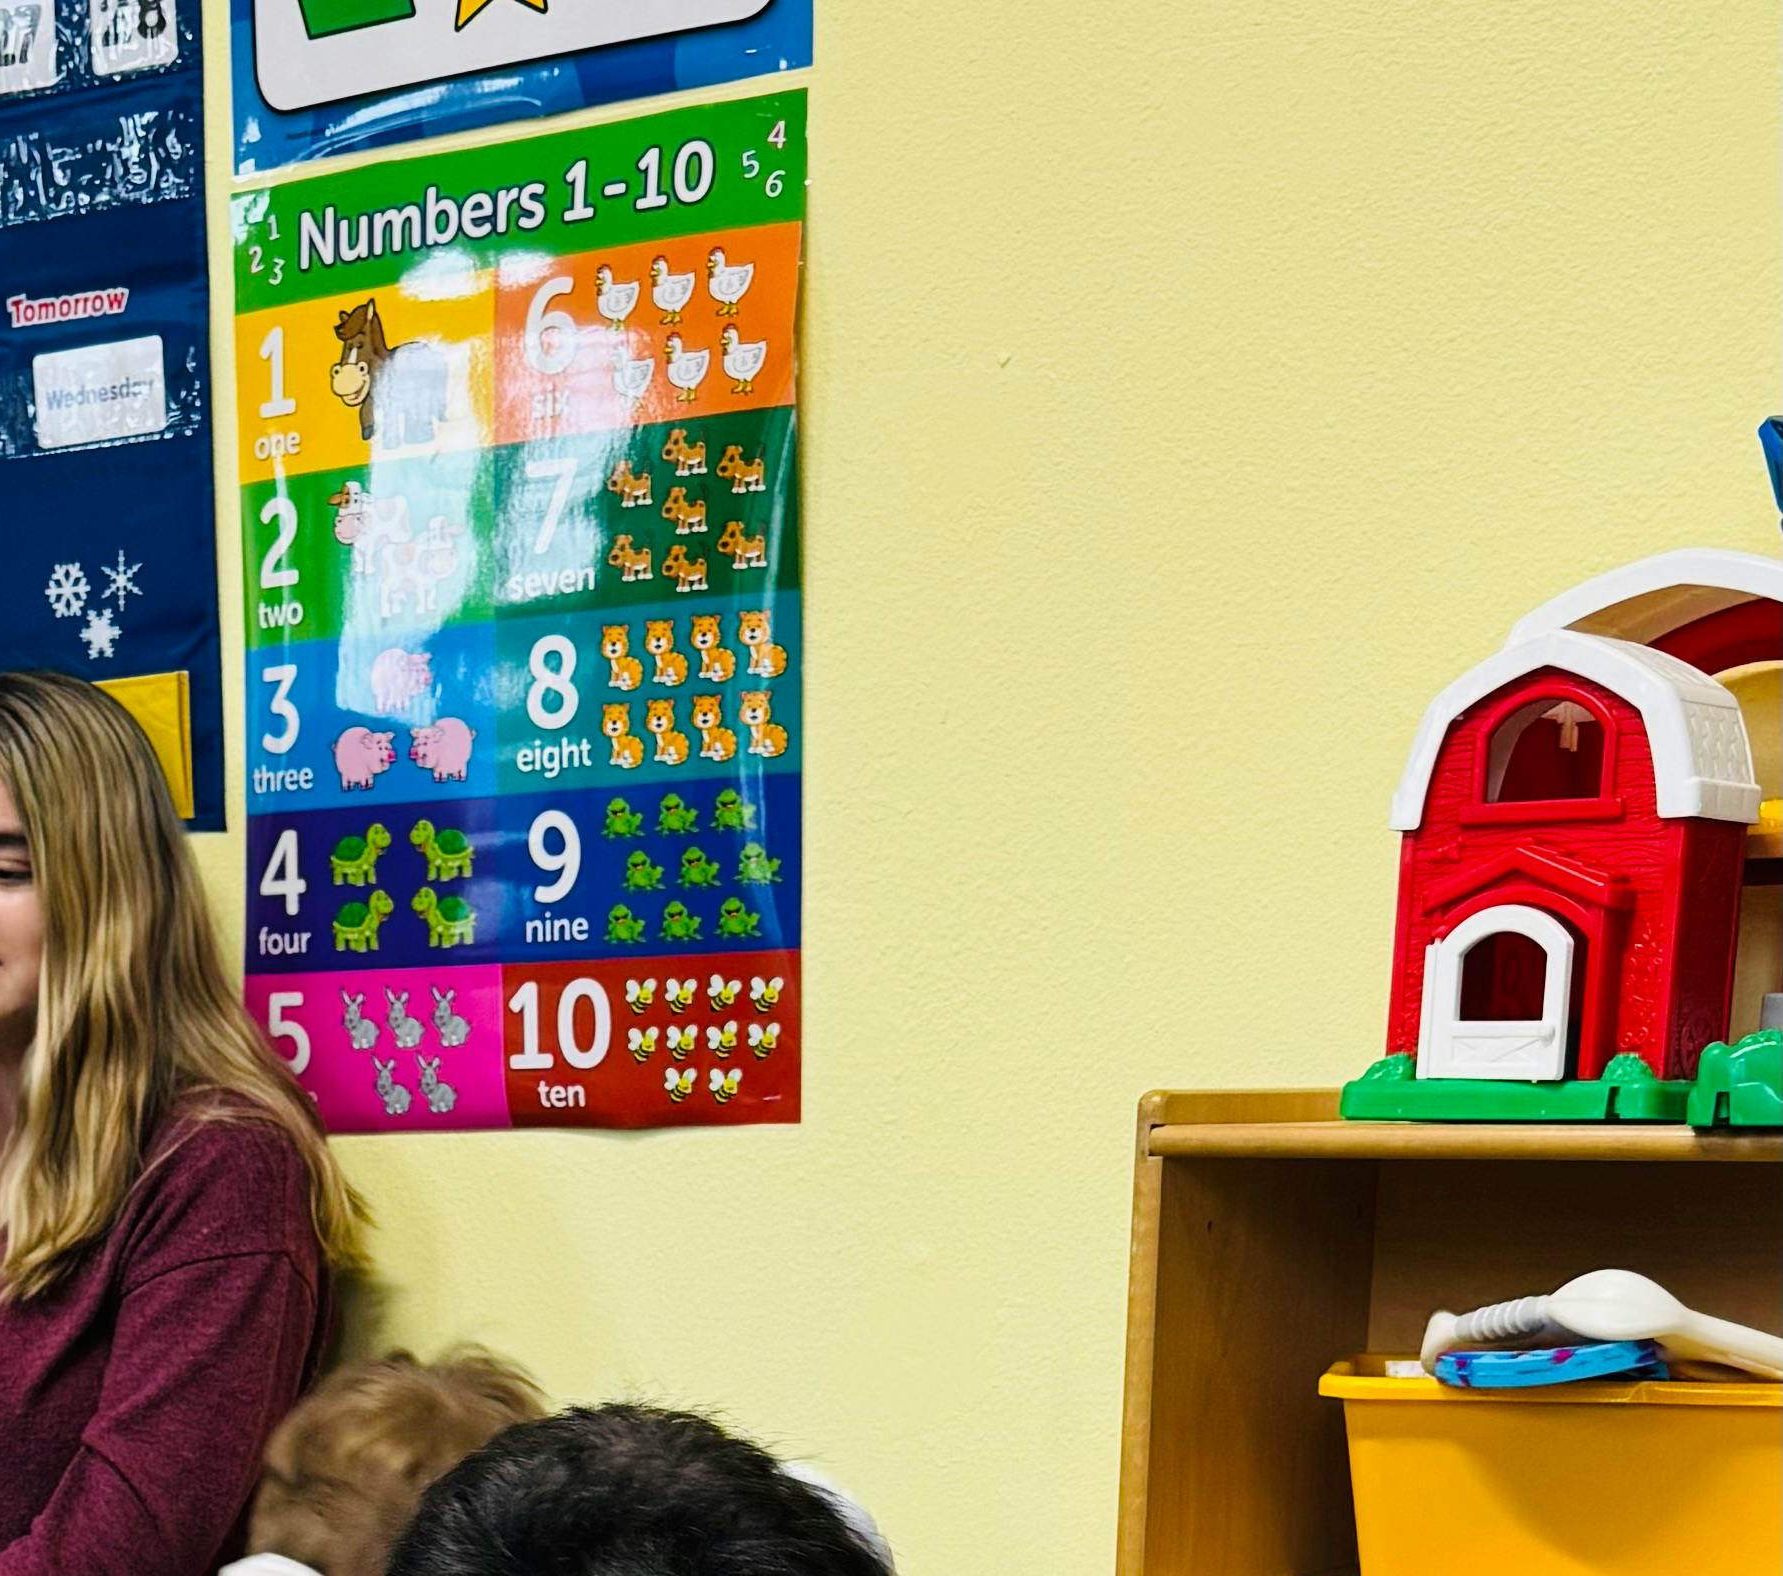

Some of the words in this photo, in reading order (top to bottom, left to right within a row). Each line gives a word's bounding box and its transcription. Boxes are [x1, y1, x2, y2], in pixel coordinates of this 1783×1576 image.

[767, 120, 787, 148] 4
[742, 151, 760, 180] 5
[765, 169, 786, 198] 6
[298, 184, 545, 272] Numbers
[562, 139, 715, 223] 1-10
[266, 215, 280, 242] 1
[248, 247, 264, 274] 2
[269, 258, 284, 286] 3
[7, 287, 129, 328] Tomorrow
[258, 326, 296, 419] 1
[524, 276, 578, 375] 6
[46, 377, 155, 411] Wednesday
[254, 430, 302, 461] one
[533, 382, 570, 420] six
[259, 495, 300, 590] 2
[525, 458, 579, 556] 7
[258, 599, 304, 631] two
[508, 564, 596, 603] seven
[261, 663, 301, 755] 3
[526, 634, 579, 730] 8
[253, 763, 314, 794] three
[516, 738, 593, 780] eight
[259, 829, 307, 916] 4
[527, 809, 582, 905] 9
[258, 925, 312, 955] four
[524, 912, 589, 945] nine
[269, 991, 311, 1075] 5
[507, 977, 611, 1070] 10
[537, 1081, 586, 1109] ten
